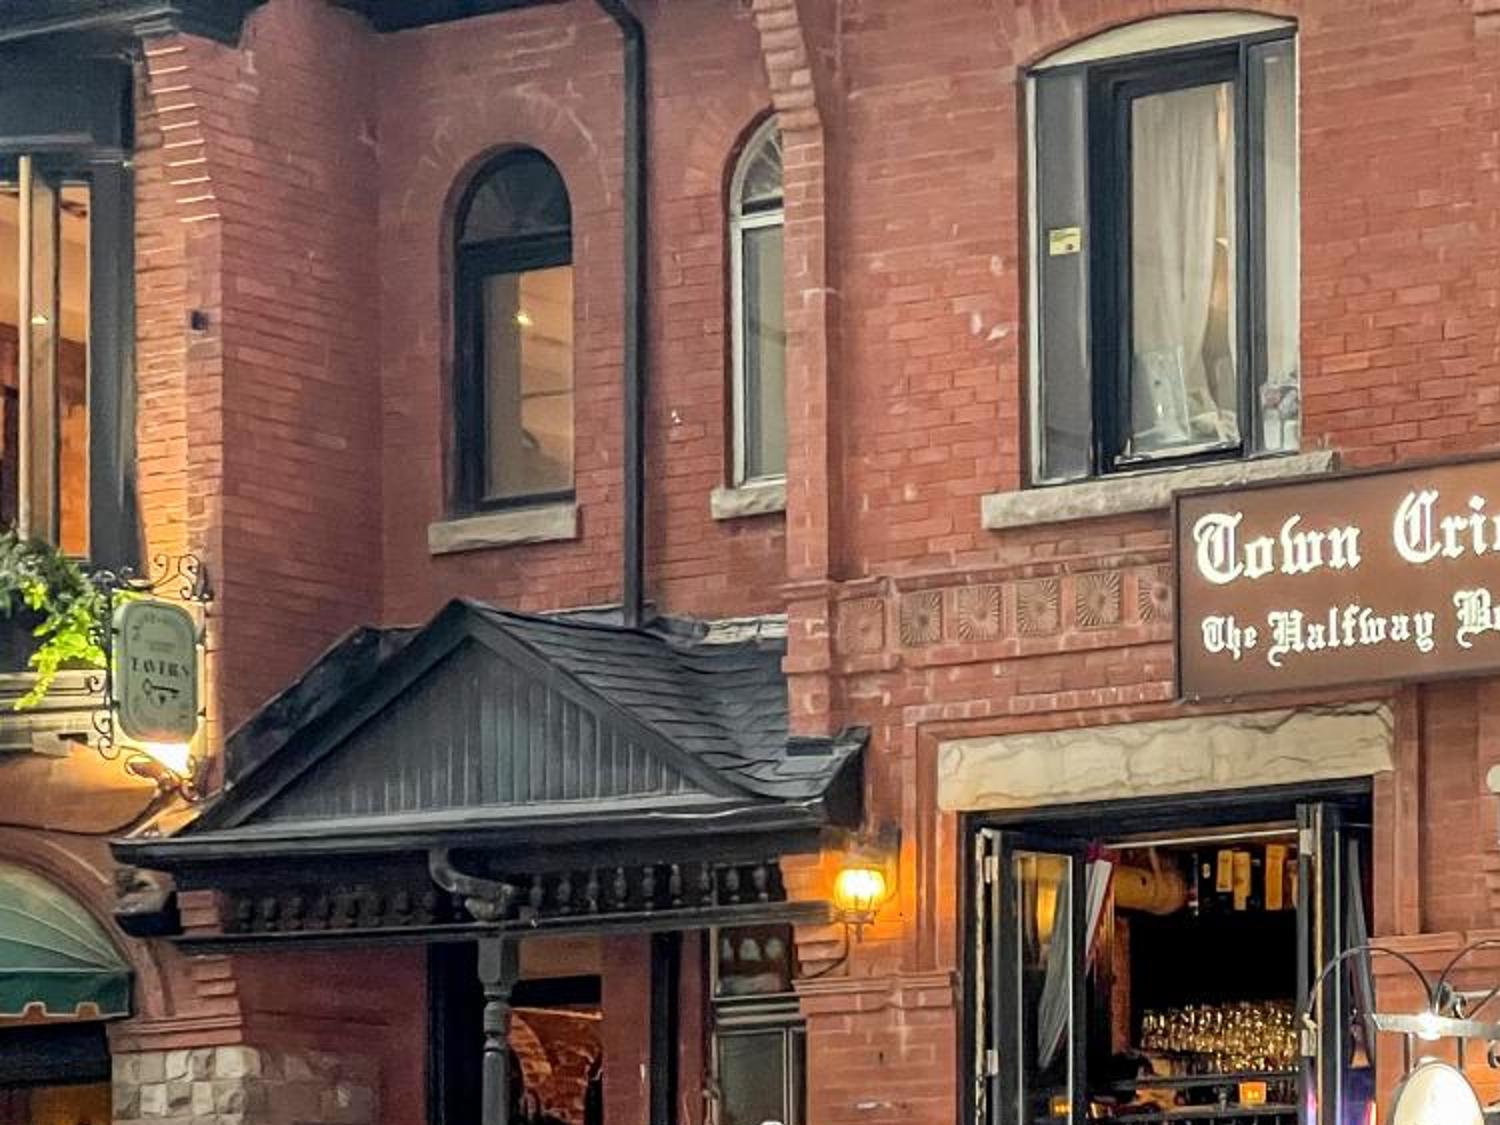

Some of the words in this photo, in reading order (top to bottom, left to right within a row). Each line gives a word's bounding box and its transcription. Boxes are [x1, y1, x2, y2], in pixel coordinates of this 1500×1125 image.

[1193, 511, 1361, 585] Town
[1202, 614, 1257, 659] The
[1267, 603, 1435, 667] Halfway
